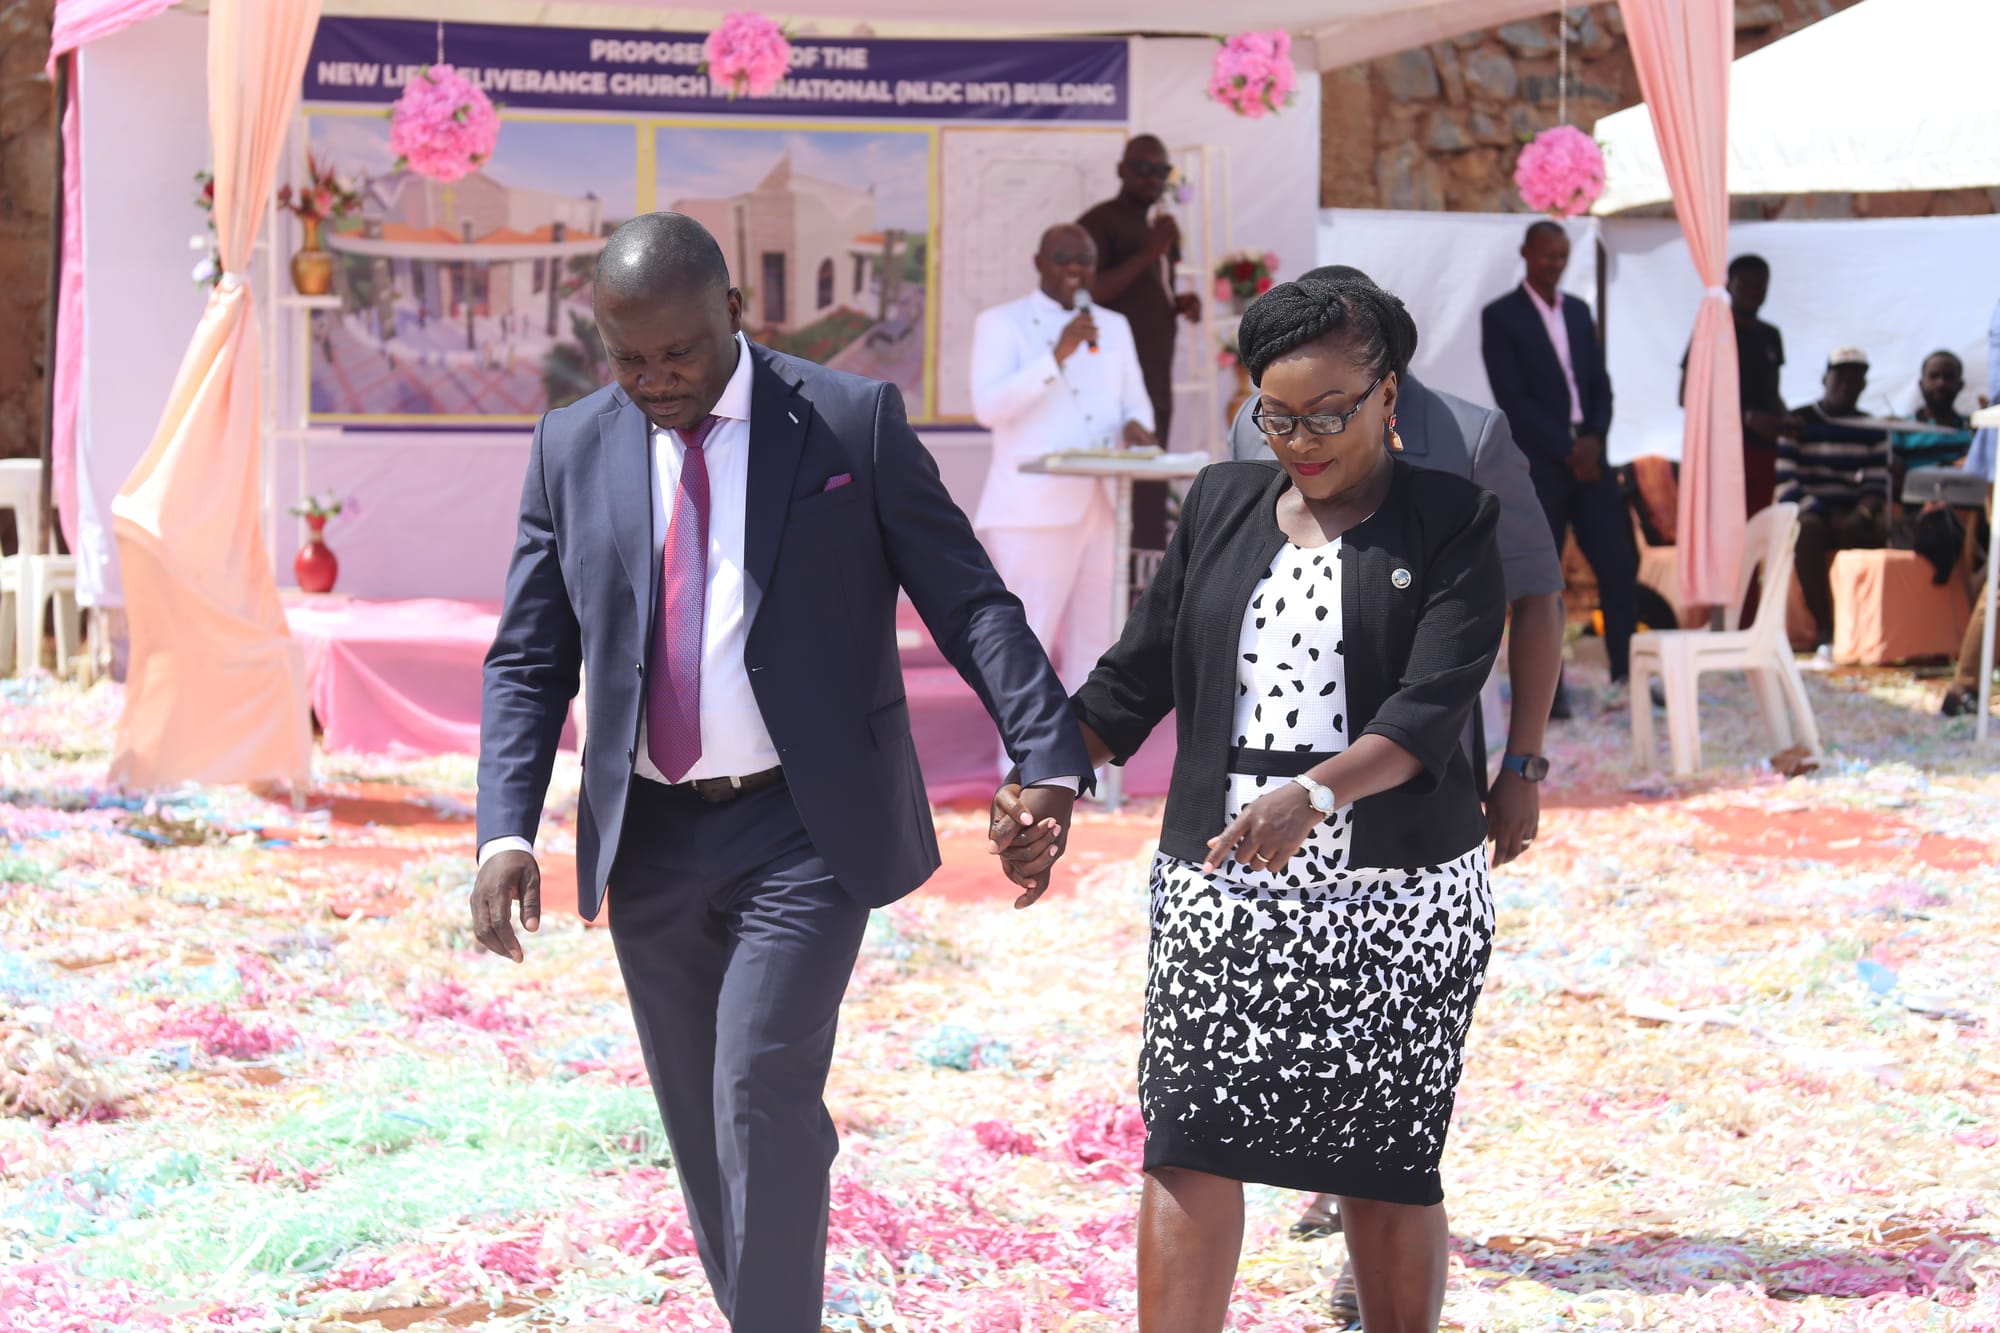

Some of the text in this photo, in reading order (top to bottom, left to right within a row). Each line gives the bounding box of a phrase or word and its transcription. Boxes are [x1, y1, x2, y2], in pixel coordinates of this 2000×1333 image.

[590, 38, 869, 70] PROPOSE OF THE
[317, 61, 380, 87] NEW
[382, 64, 419, 88] LIF
[609, 73, 708, 97] CHURCH
[895, 80, 962, 105] (NLDC
[965, 82, 1010, 107] INT)
[1013, 82, 1117, 105] BUILDING
